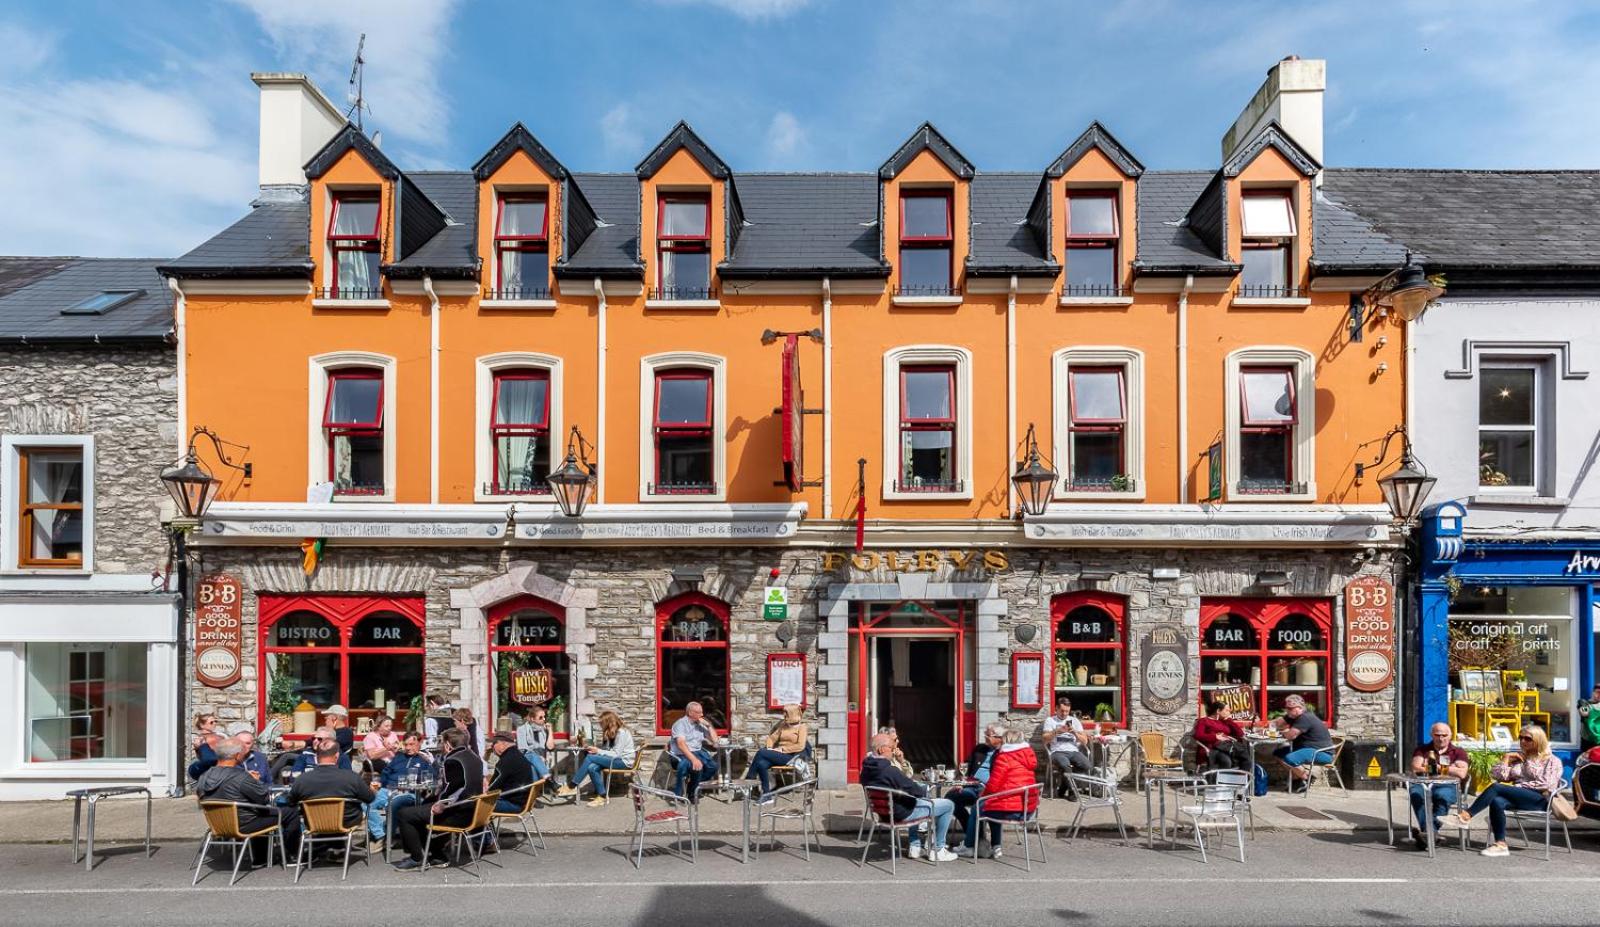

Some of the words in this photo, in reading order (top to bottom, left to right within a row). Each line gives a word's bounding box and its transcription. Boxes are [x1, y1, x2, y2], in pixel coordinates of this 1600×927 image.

[699, 525, 716, 534] Bed
[718, 525, 726, 534] &
[729, 524, 769, 534] Breakfast
[1291, 527, 1309, 537] Irish
[1310, 527, 1334, 538] Music
[205, 612, 231, 620] GOOD
[198, 619, 238, 628] FOOD
[1349, 621, 1390, 631] FOOD
[279, 626, 331, 639] BISTRO
[373, 627, 401, 639] BAR
[1215, 629, 1244, 641] BAR
[1471, 622, 1524, 637] original
[1528, 623, 1548, 634] art
[200, 631, 237, 640] DRINK
[1278, 630, 1312, 642] FOOD
[1350, 634, 1388, 643] DRINK
[1456, 637, 1490, 650] craft
[1523, 637, 1561, 652] prints
[1148, 671, 1184, 679] GUINNESS
[515, 676, 548, 694] MUSIC
[517, 694, 547, 703] Tonight
